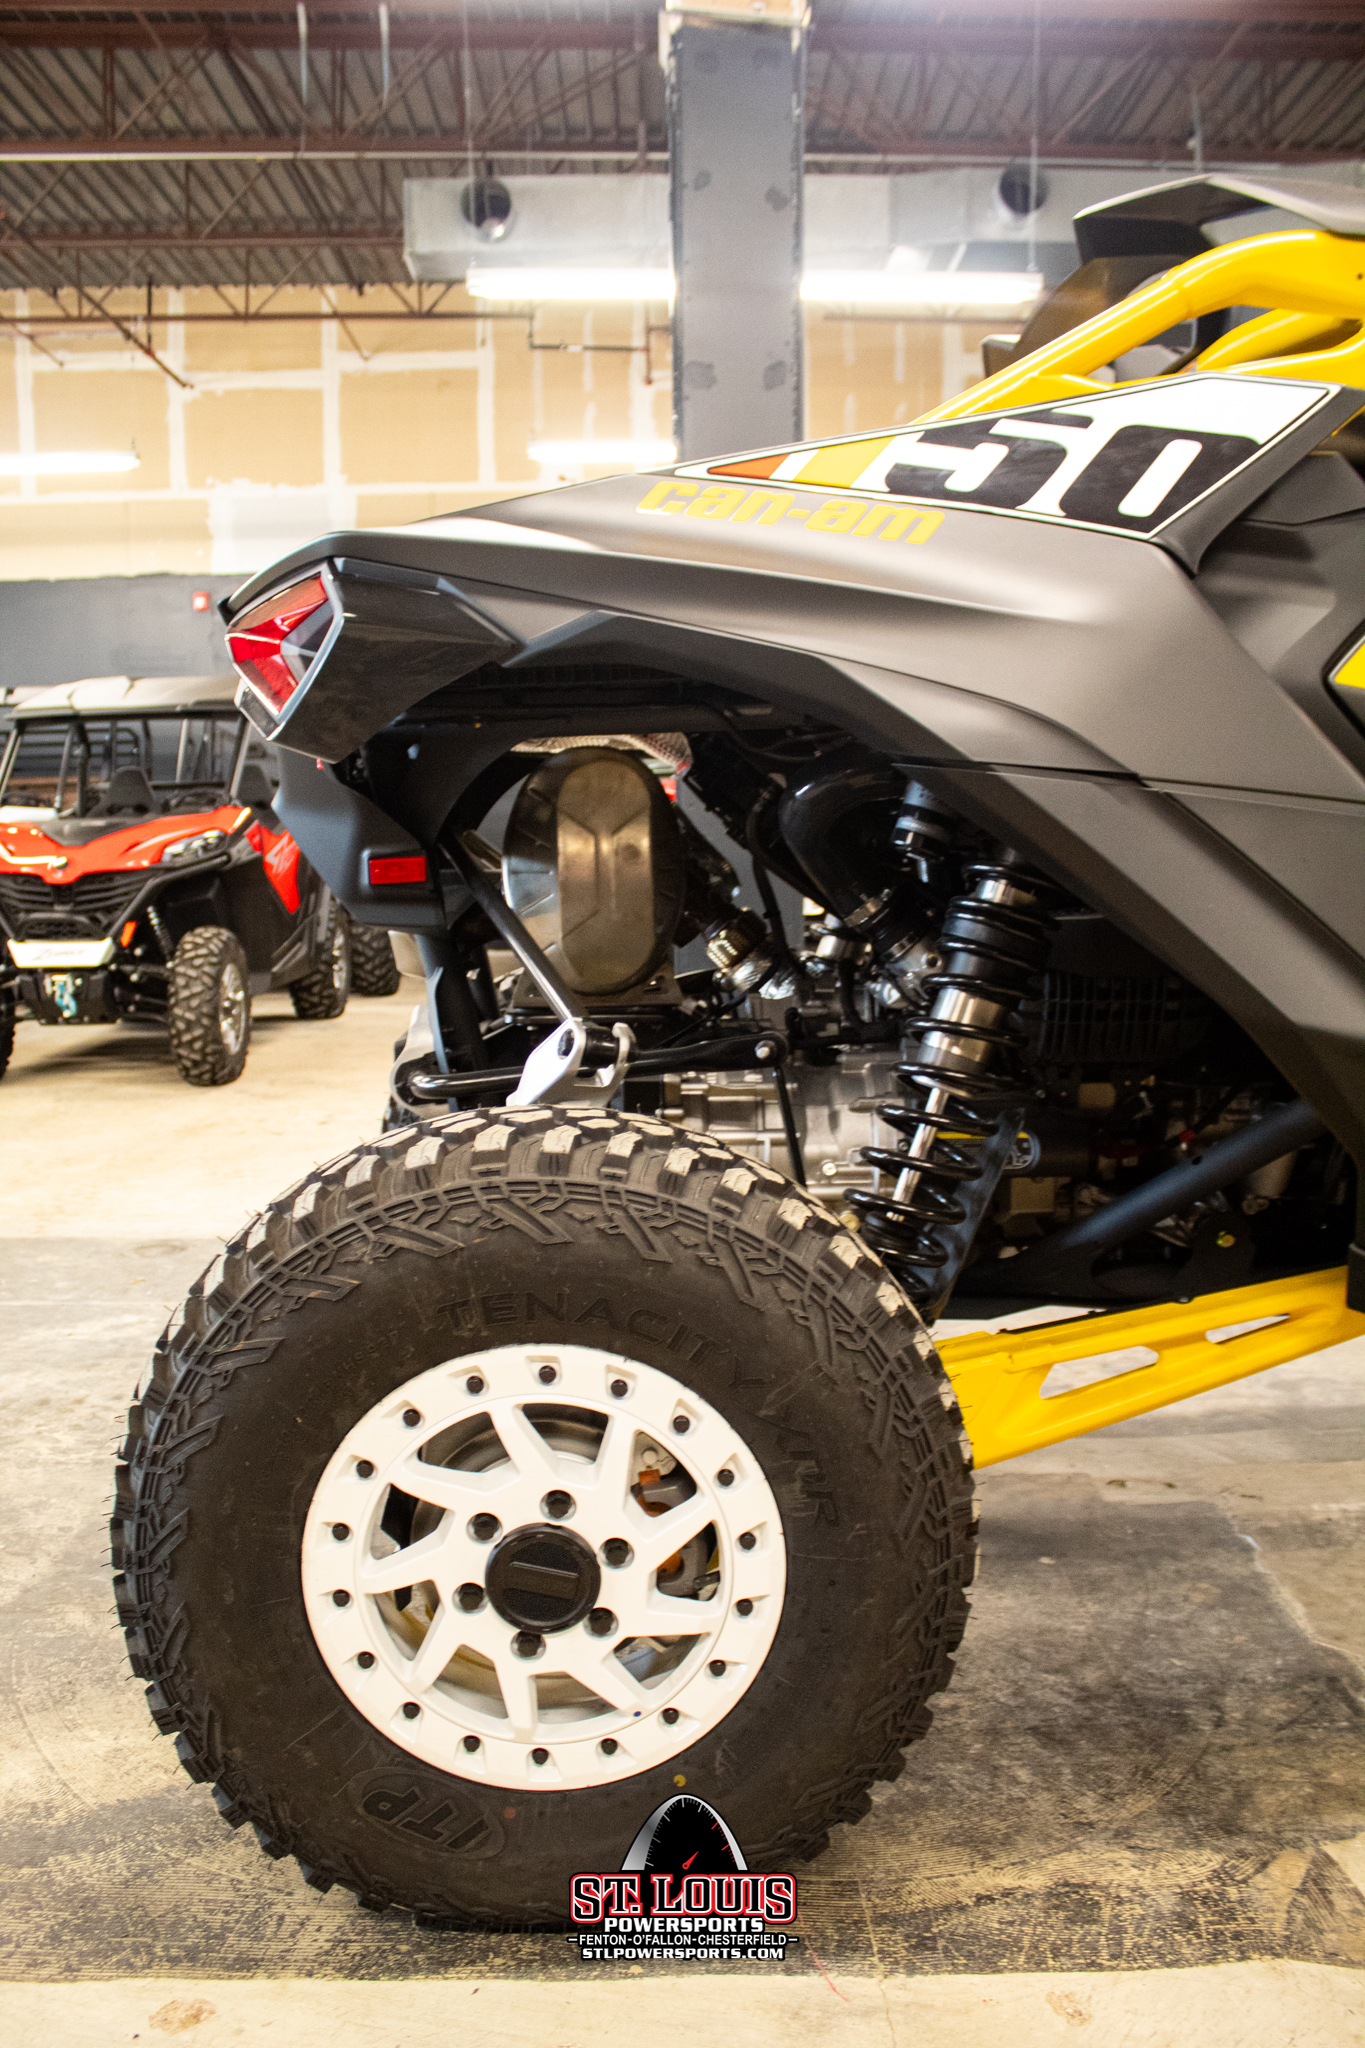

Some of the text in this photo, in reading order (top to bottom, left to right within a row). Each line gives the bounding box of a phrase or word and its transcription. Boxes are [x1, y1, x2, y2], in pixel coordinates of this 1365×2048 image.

[636, 481, 945, 544] can-am
[884, 408, 1265, 534] 50
[435, 1290, 771, 1391] TENACITY
[361, 1785, 490, 1850] ITP
